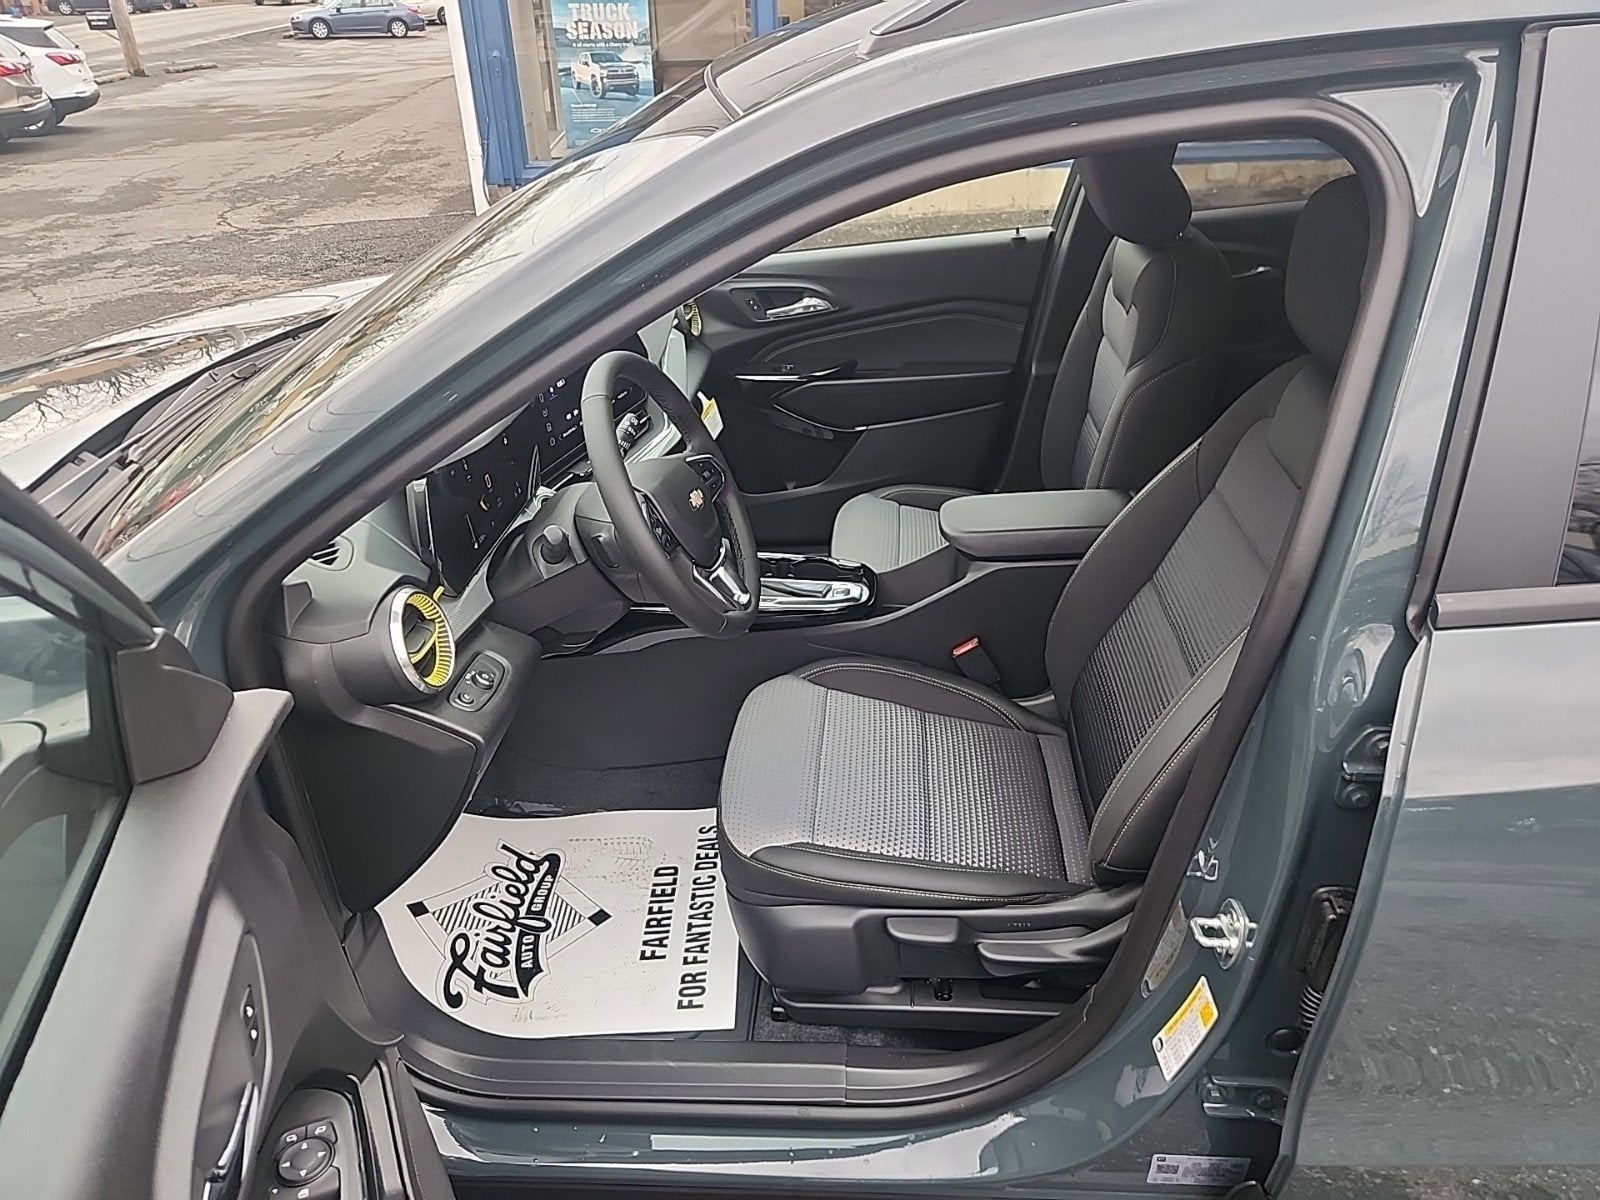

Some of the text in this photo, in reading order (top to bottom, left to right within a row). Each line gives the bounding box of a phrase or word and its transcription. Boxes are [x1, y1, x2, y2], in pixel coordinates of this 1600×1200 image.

[566, 21, 639, 40] SEASON
[568, 3, 631, 21] TRUCK
[444, 842, 561, 1008] Fairfield
[520, 874, 554, 969] AUTO GROUP
[639, 865, 680, 962] FAIRFIELD
[676, 825, 718, 1011] FOR FANTASTIC DEALS
